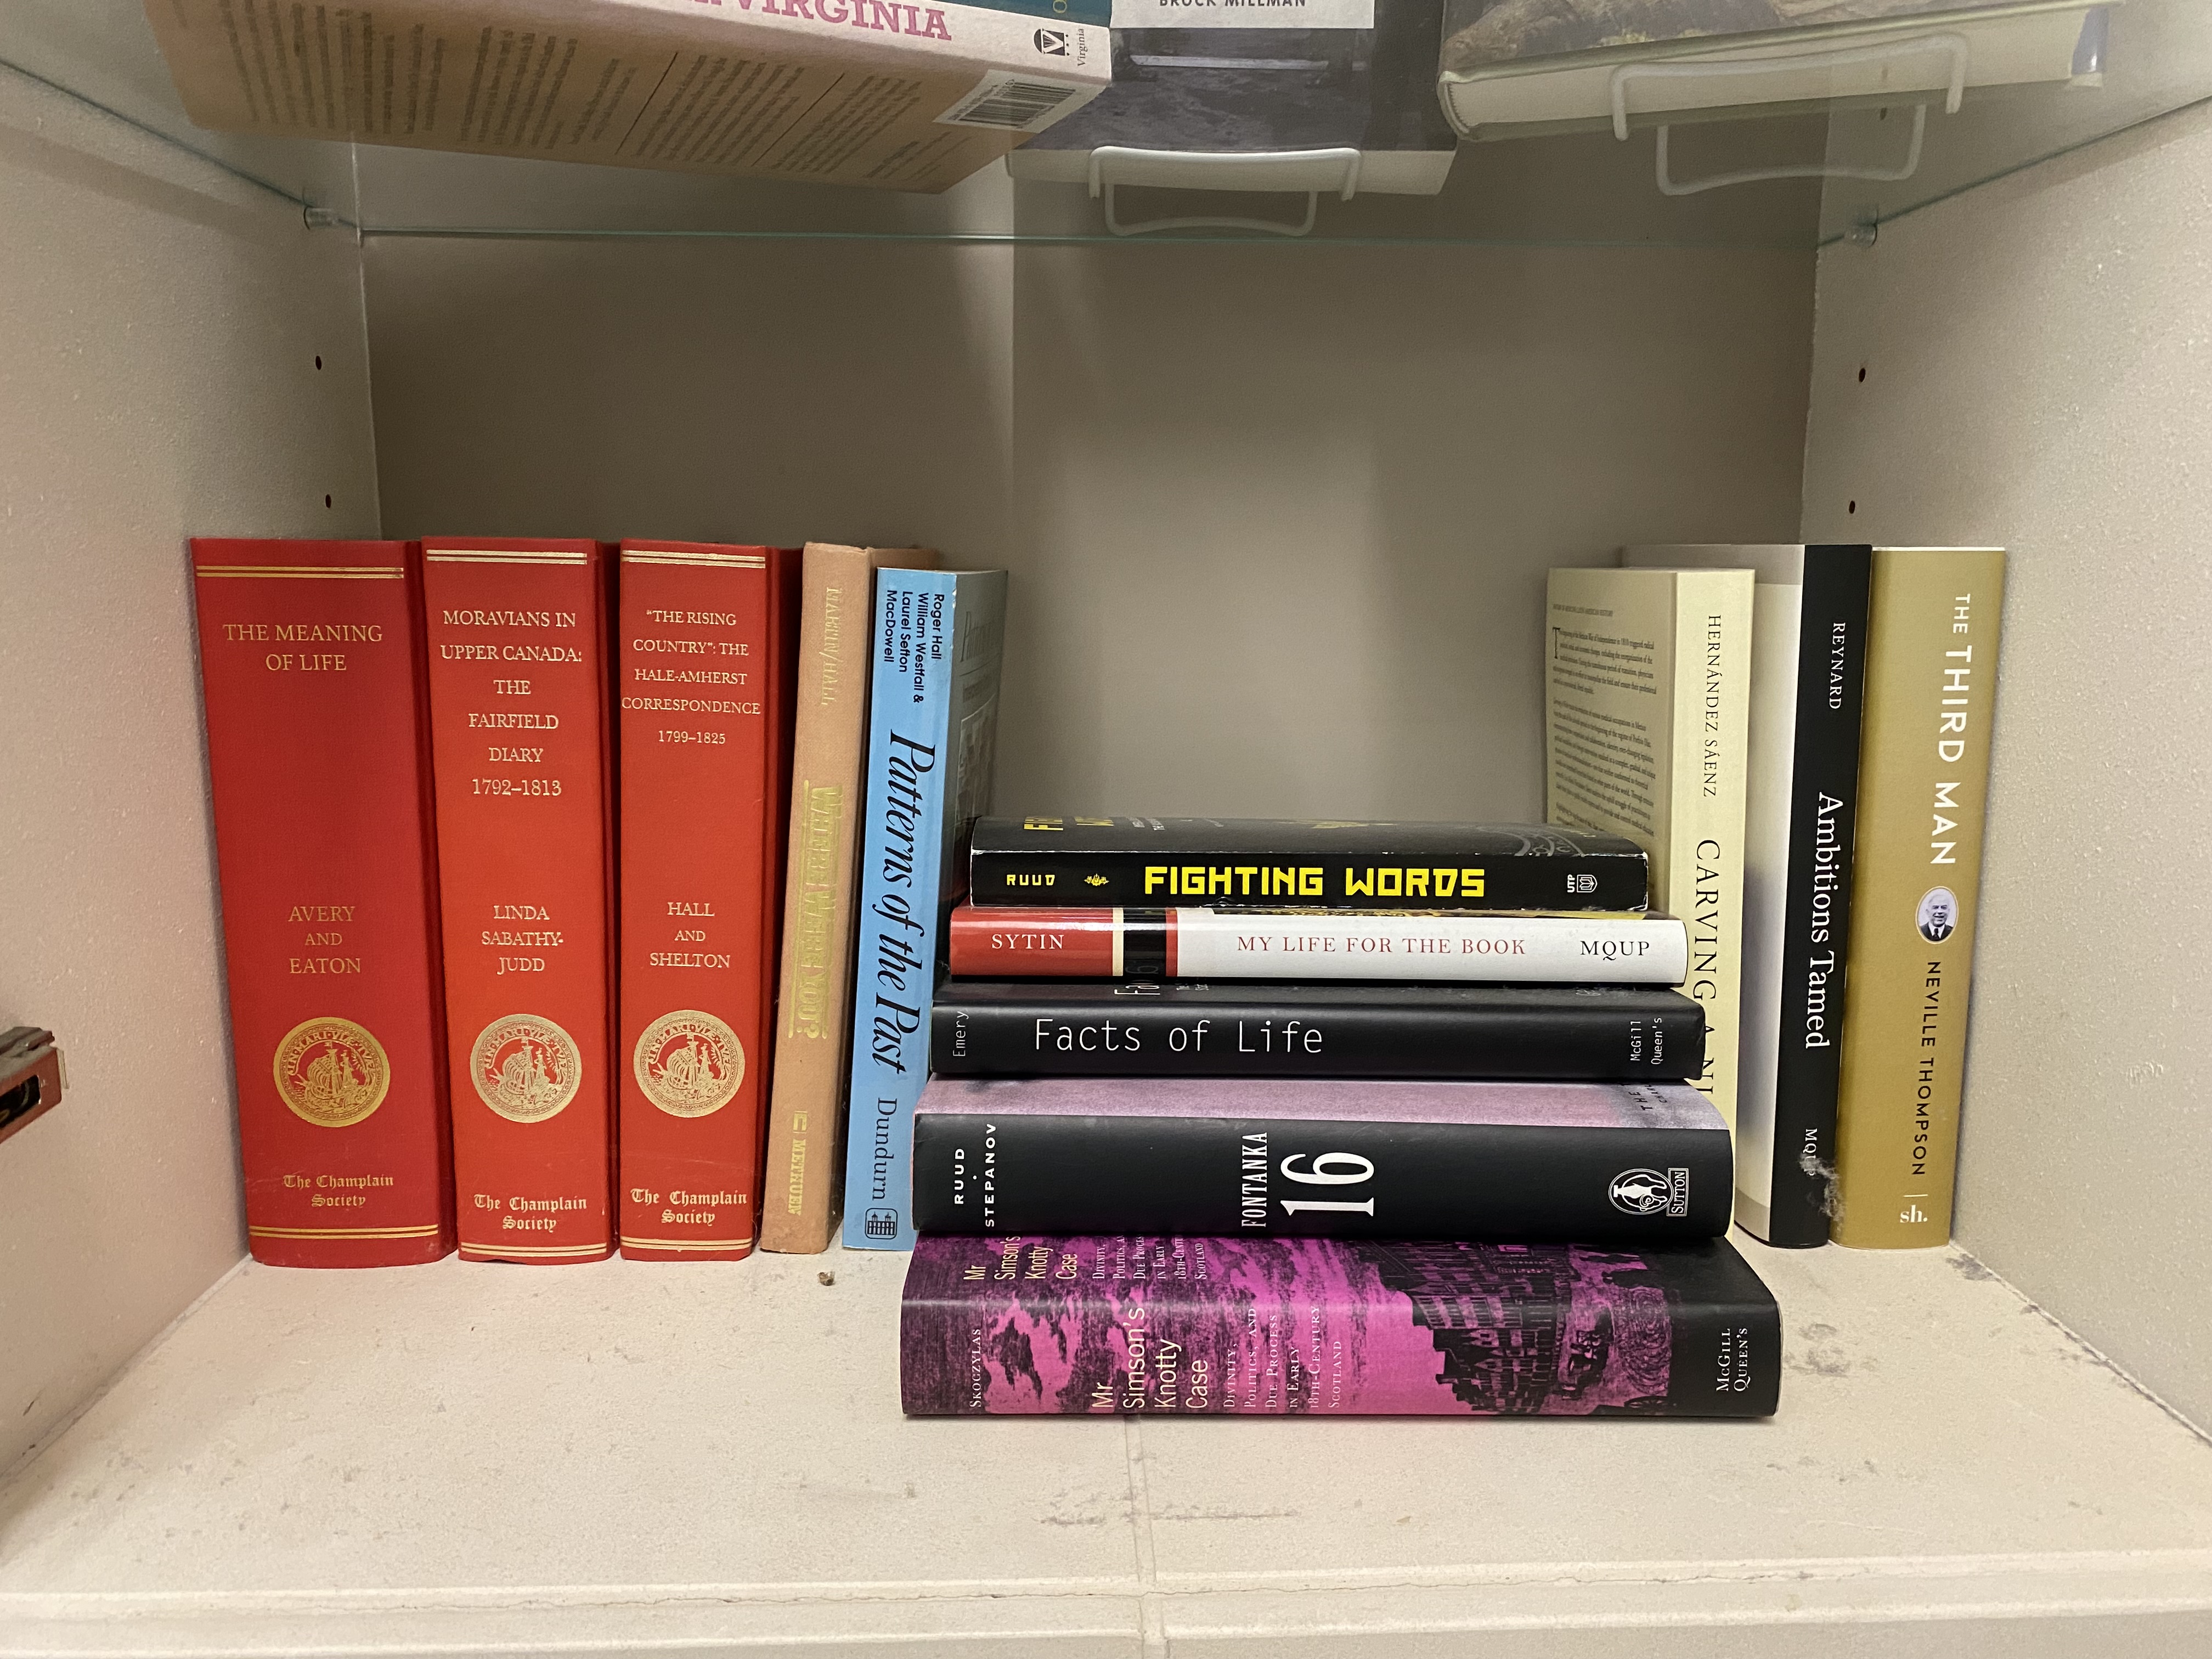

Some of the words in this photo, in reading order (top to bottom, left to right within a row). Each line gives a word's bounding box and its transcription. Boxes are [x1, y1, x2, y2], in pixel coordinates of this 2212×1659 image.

[1076, 28, 1088, 66] Virginia
[443, 610, 550, 627] MORAVIANS
[555, 612, 576, 628] IN
[687, 612, 736, 625] RISING
[884, 590, 898, 663] MacDowell
[902, 591, 912, 628] Laurel
[916, 592, 929, 638] William
[930, 594, 944, 636] Roger
[1953, 594, 1971, 634] THE
[224, 624, 269, 641] THE
[275, 624, 383, 642] MEANING
[719, 643, 749, 656] THE
[819, 587, 843, 706] MARTIN/HALL
[932, 637, 943, 660] Hall
[266, 653, 293, 672] OF
[300, 654, 347, 672] LIFE
[441, 645, 499, 661] UPPER
[503, 645, 582, 662] CANADA:
[899, 634, 911, 673] Sefton
[913, 642, 927, 694] Westfall
[1829, 622, 1846, 709] REYNARD
[494, 679, 531, 695] THE
[635, 669, 747, 685] HALE-AMHERST
[1705, 614, 1723, 732] HERNÁNDEZ
[469, 714, 559, 730] FAIRFIELD
[622, 697, 760, 714] CORRESPONDENCE
[1938, 645, 1972, 762] THIRD
[488, 747, 544, 763] DIARY
[1703, 740, 1718, 797] SÁENZ
[882, 729, 935, 888] Patterns
[1930, 782, 1961, 864] MAN
[805, 785, 843, 887] WHERE
[1007, 874, 1055, 885] RUUD
[1145, 867, 1323, 895] FIGHTING
[1346, 868, 1485, 897] WORDS
[1810, 792, 1844, 943] Ambitions
[289, 906, 356, 922] AVERY
[494, 905, 550, 921] LINDA
[667, 902, 715, 917] HALL
[873, 894, 924, 936] of
[1692, 840, 1720, 1001] CARVING
[304, 933, 342, 946] AND
[481, 932, 563, 946] SABATHY-
[674, 930, 706, 941] AND
[801, 891, 837, 968] WERE
[992, 934, 1065, 950] SYTIN
[1237, 936, 1272, 951] MY
[1283, 936, 1336, 952] LIFE
[1346, 938, 1392, 953] FOR
[1402, 939, 1451, 954] THE
[1462, 939, 1526, 955] BOOK
[290, 958, 361, 974] EATON
[497, 958, 545, 975] JUDD
[650, 952, 730, 968] SHELTON
[877, 934, 922, 991] the
[1580, 940, 1650, 961] MQUP
[797, 970, 827, 1039] YOU?
[1805, 951, 1835, 1048] Tamed
[1921, 962, 1941, 1047] NEVILLE
[872, 992, 921, 1074] Past
[953, 1011, 969, 1057] Emery
[1035, 1018, 1141, 1052] Facts
[1169, 1020, 1210, 1052] of
[1239, 1020, 1323, 1053] Life
[1630, 1020, 1641, 1062] McGill
[1650, 1017, 1662, 1065] Queen's
[1912, 1058, 1934, 1175] THOMPSON
[872, 1098, 898, 1200] Dundurn
[283, 1175, 311, 1189] The
[316, 1174, 394, 1189] Champlain
[788, 1139, 806, 1216] METHUEN
[954, 1148, 964, 1204] RUUD
[985, 1124, 996, 1227] STEPANOV
[1242, 1132, 1267, 1227] FONTANKA
[1280, 1152, 1374, 1217] 16
[1671, 1172, 1685, 1214] SUTTON
[311, 1194, 366, 1209] Society
[474, 1194, 501, 1211] The
[509, 1197, 587, 1213] Champlain
[631, 1189, 659, 1204] The
[669, 1190, 747, 1206] Champlain
[1900, 1205, 1928, 1223] sh.
[502, 1216, 556, 1232] Society
[661, 1209, 715, 1227] Society
[963, 1265, 986, 1280] Mr
[1024, 1246, 1053, 1279] Knotty
[1056, 1254, 1077, 1279] Case
[970, 1329, 981, 1407] SKOCZYLAS
[1154, 1339, 1182, 1407] Knotty
[1186, 1359, 1208, 1408] Case
[1091, 1382, 1114, 1408] Mr
